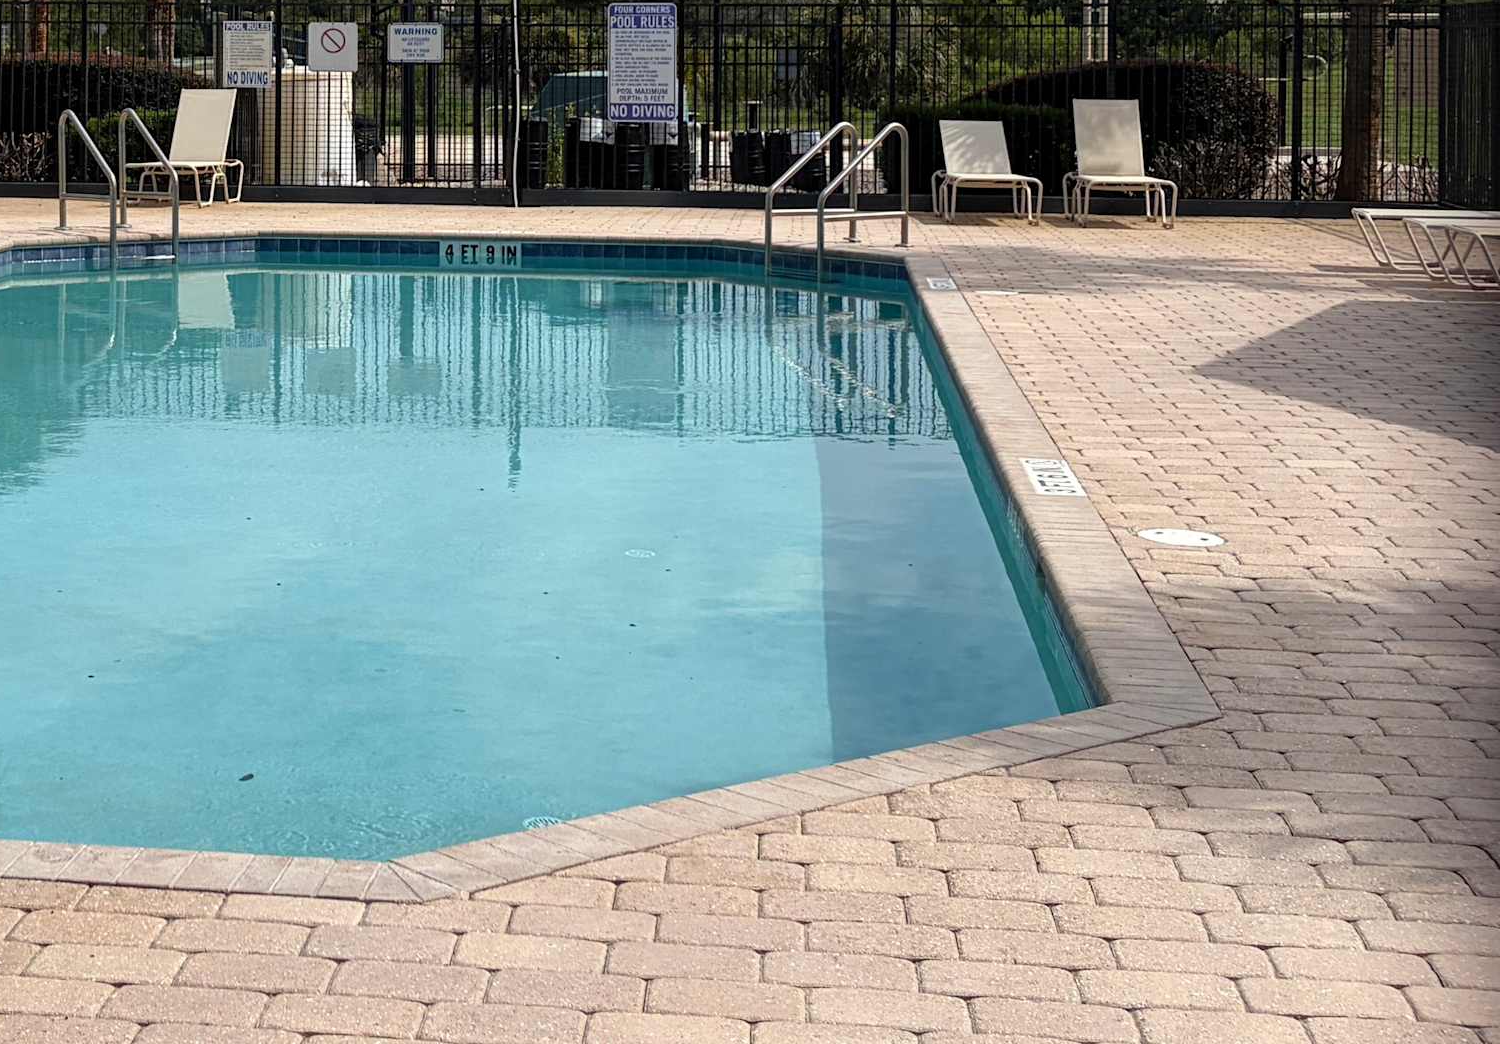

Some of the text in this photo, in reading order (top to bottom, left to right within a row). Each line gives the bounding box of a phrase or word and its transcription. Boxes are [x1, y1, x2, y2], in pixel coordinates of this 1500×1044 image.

[611, 16, 675, 28] POOL RULES
[394, 27, 438, 35] WARNING
[228, 71, 268, 85] NO DIVING
[610, 104, 675, 118] NO DIVING
